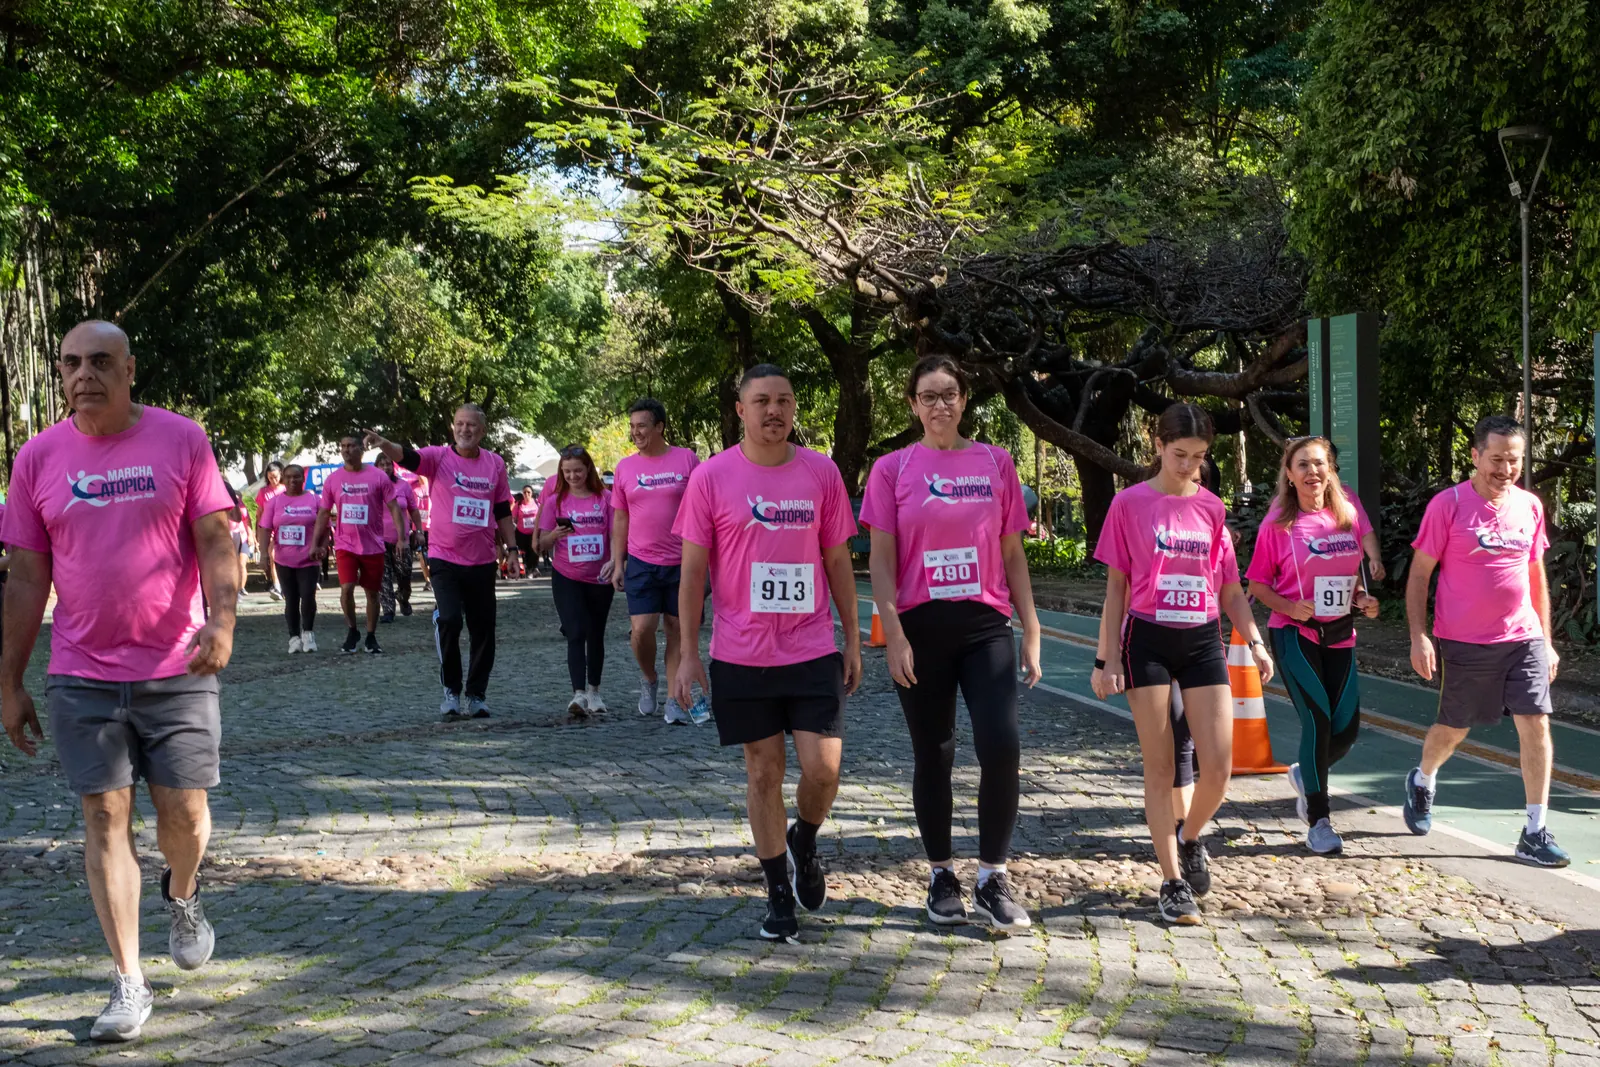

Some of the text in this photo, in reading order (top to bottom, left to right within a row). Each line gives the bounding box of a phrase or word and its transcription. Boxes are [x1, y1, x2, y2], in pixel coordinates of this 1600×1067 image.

[107, 465, 153, 481] MARCHA
[101, 477, 156, 498] ATÓPICA
[956, 476, 990, 486] MARCHA
[952, 484, 993, 497] ATÓPICA
[460, 505, 482, 517] 479
[780, 500, 814, 510] MARCHA
[774, 508, 815, 523] ATÓPICA
[575, 544, 597, 553] 434
[932, 564, 971, 582] 490
[761, 580, 805, 602] 913
[1163, 591, 1200, 607] 483
